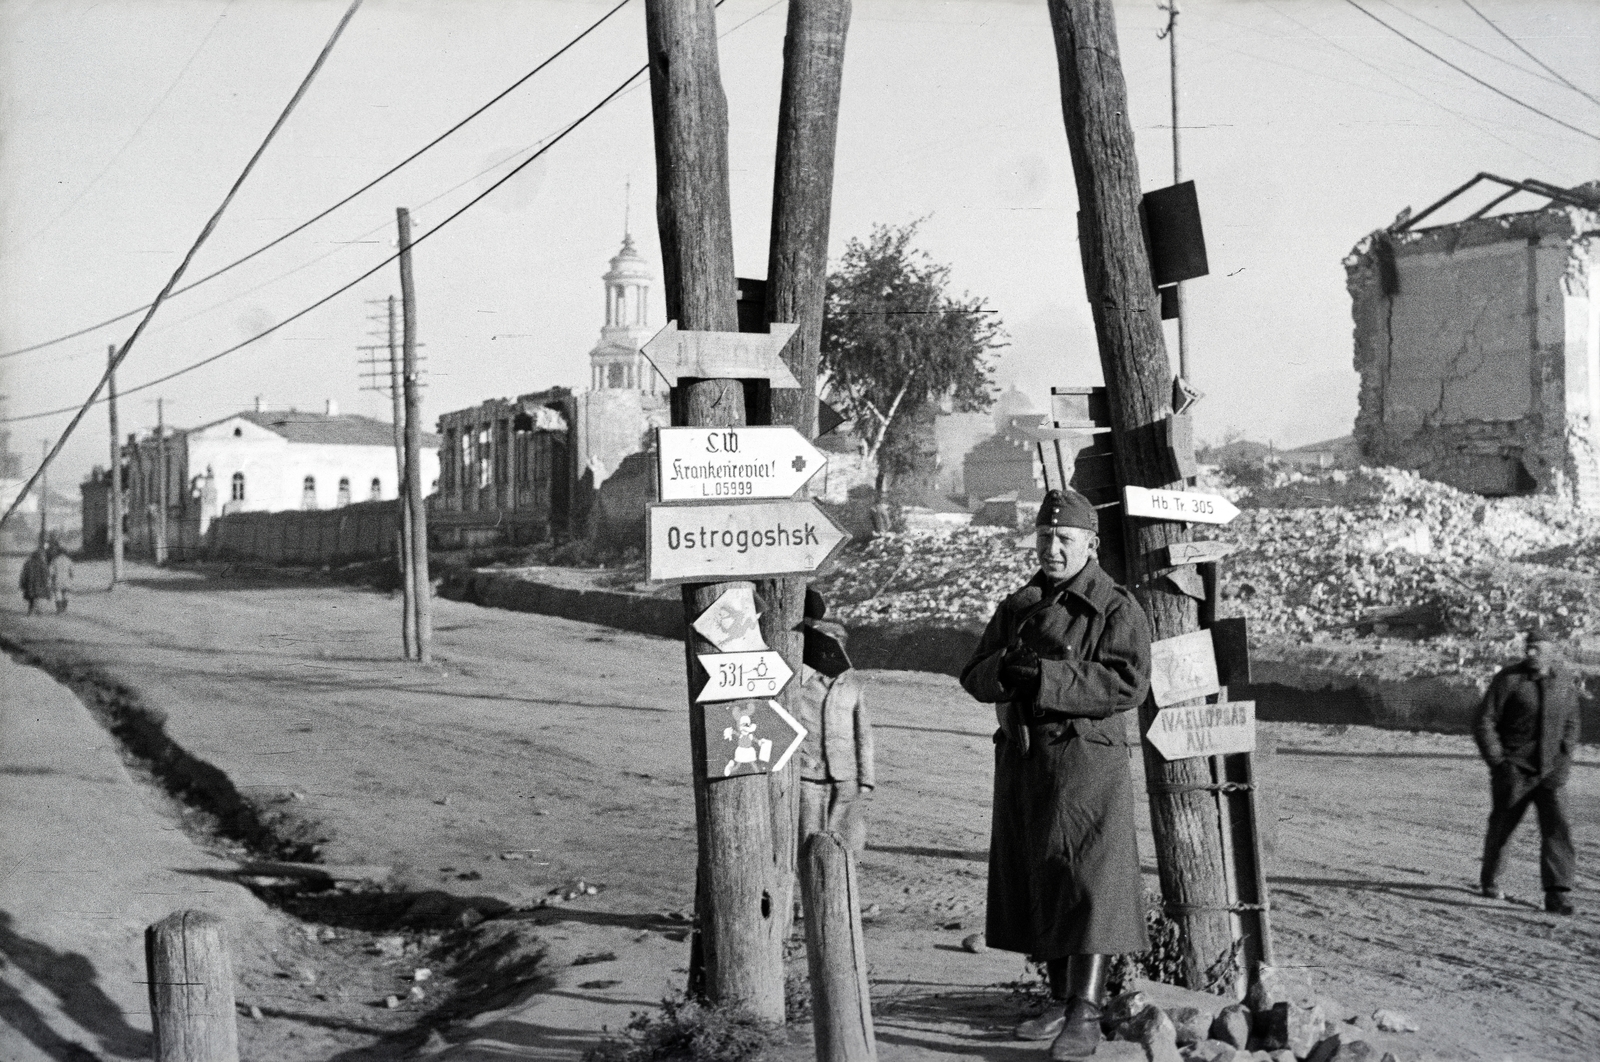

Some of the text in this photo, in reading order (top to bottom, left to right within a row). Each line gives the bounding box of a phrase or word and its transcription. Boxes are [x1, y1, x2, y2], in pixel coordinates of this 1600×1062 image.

[1192, 499, 1214, 515] 305
[667, 522, 819, 554] Ostrogoshsk
[719, 662, 744, 688] 531
